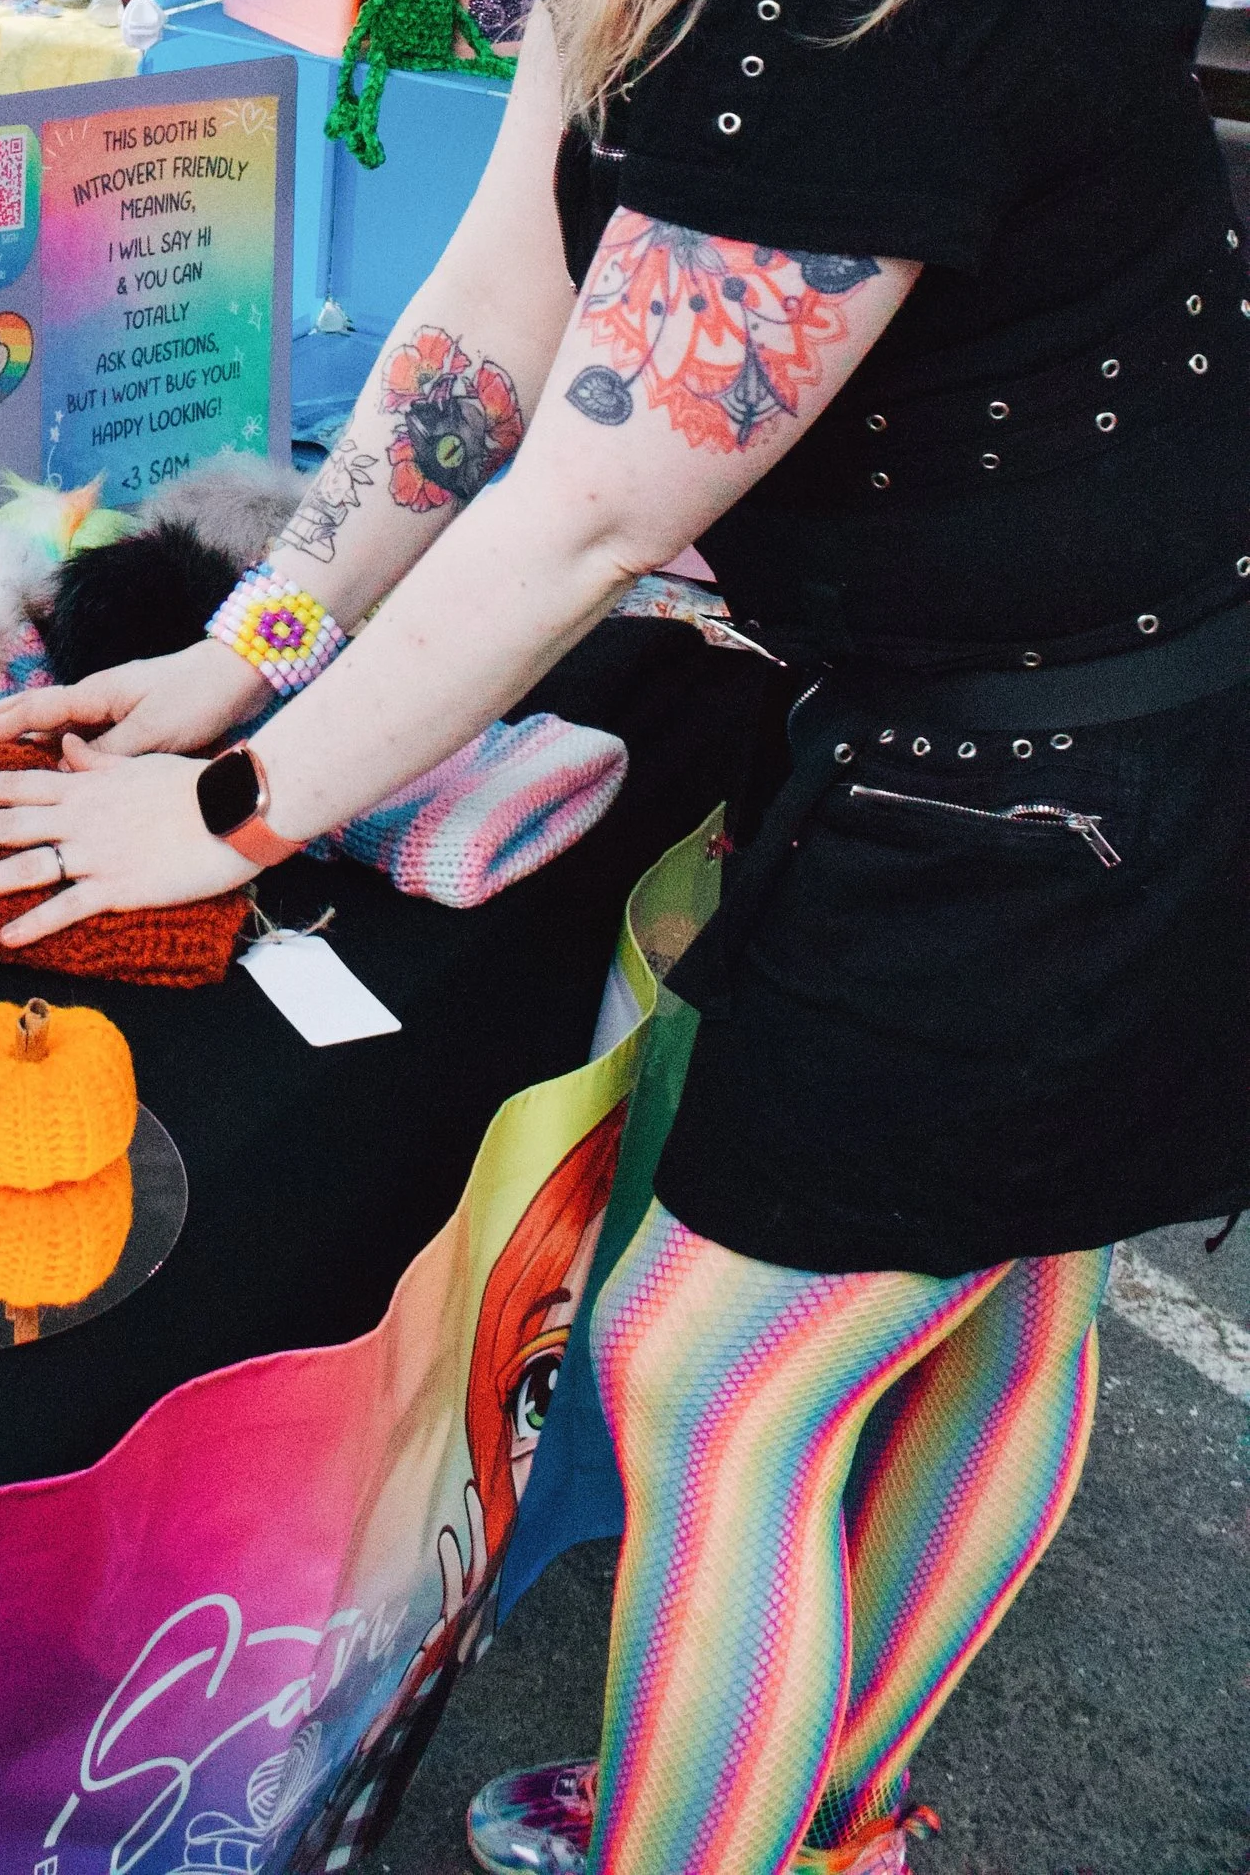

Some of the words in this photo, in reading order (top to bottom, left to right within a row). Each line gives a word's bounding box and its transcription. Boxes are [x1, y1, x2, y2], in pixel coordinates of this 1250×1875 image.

[103, 128, 137, 152] THIS
[143, 119, 198, 147] BOOTH
[203, 117, 217, 138] IS
[73, 158, 168, 207] INTROVERT
[173, 156, 249, 181] FRIENDLY
[121, 190, 196, 221] MEANING,
[108, 242, 113, 262] I
[119, 236, 156, 260] WILL
[161, 229, 193, 254] SAY
[197, 226, 212, 247] HI
[116, 276, 128, 295] &
[134, 268, 168, 292] YOU
[173, 261, 203, 285] CAN
[123, 301, 190, 330] TOTALLY
[96, 350, 126, 375] ASK
[131, 332, 220, 368] QUESTIONS,
[67, 389, 97, 414] BUT
[112, 377, 161, 404] WON'T
[166, 370, 196, 393] BUG
[202, 361, 241, 385] YOU!!
[91, 415, 144, 446] HAPPY
[150, 397, 222, 433] LOOKING!
[122, 465, 142, 491] <3
[150, 453, 190, 485] SAM
